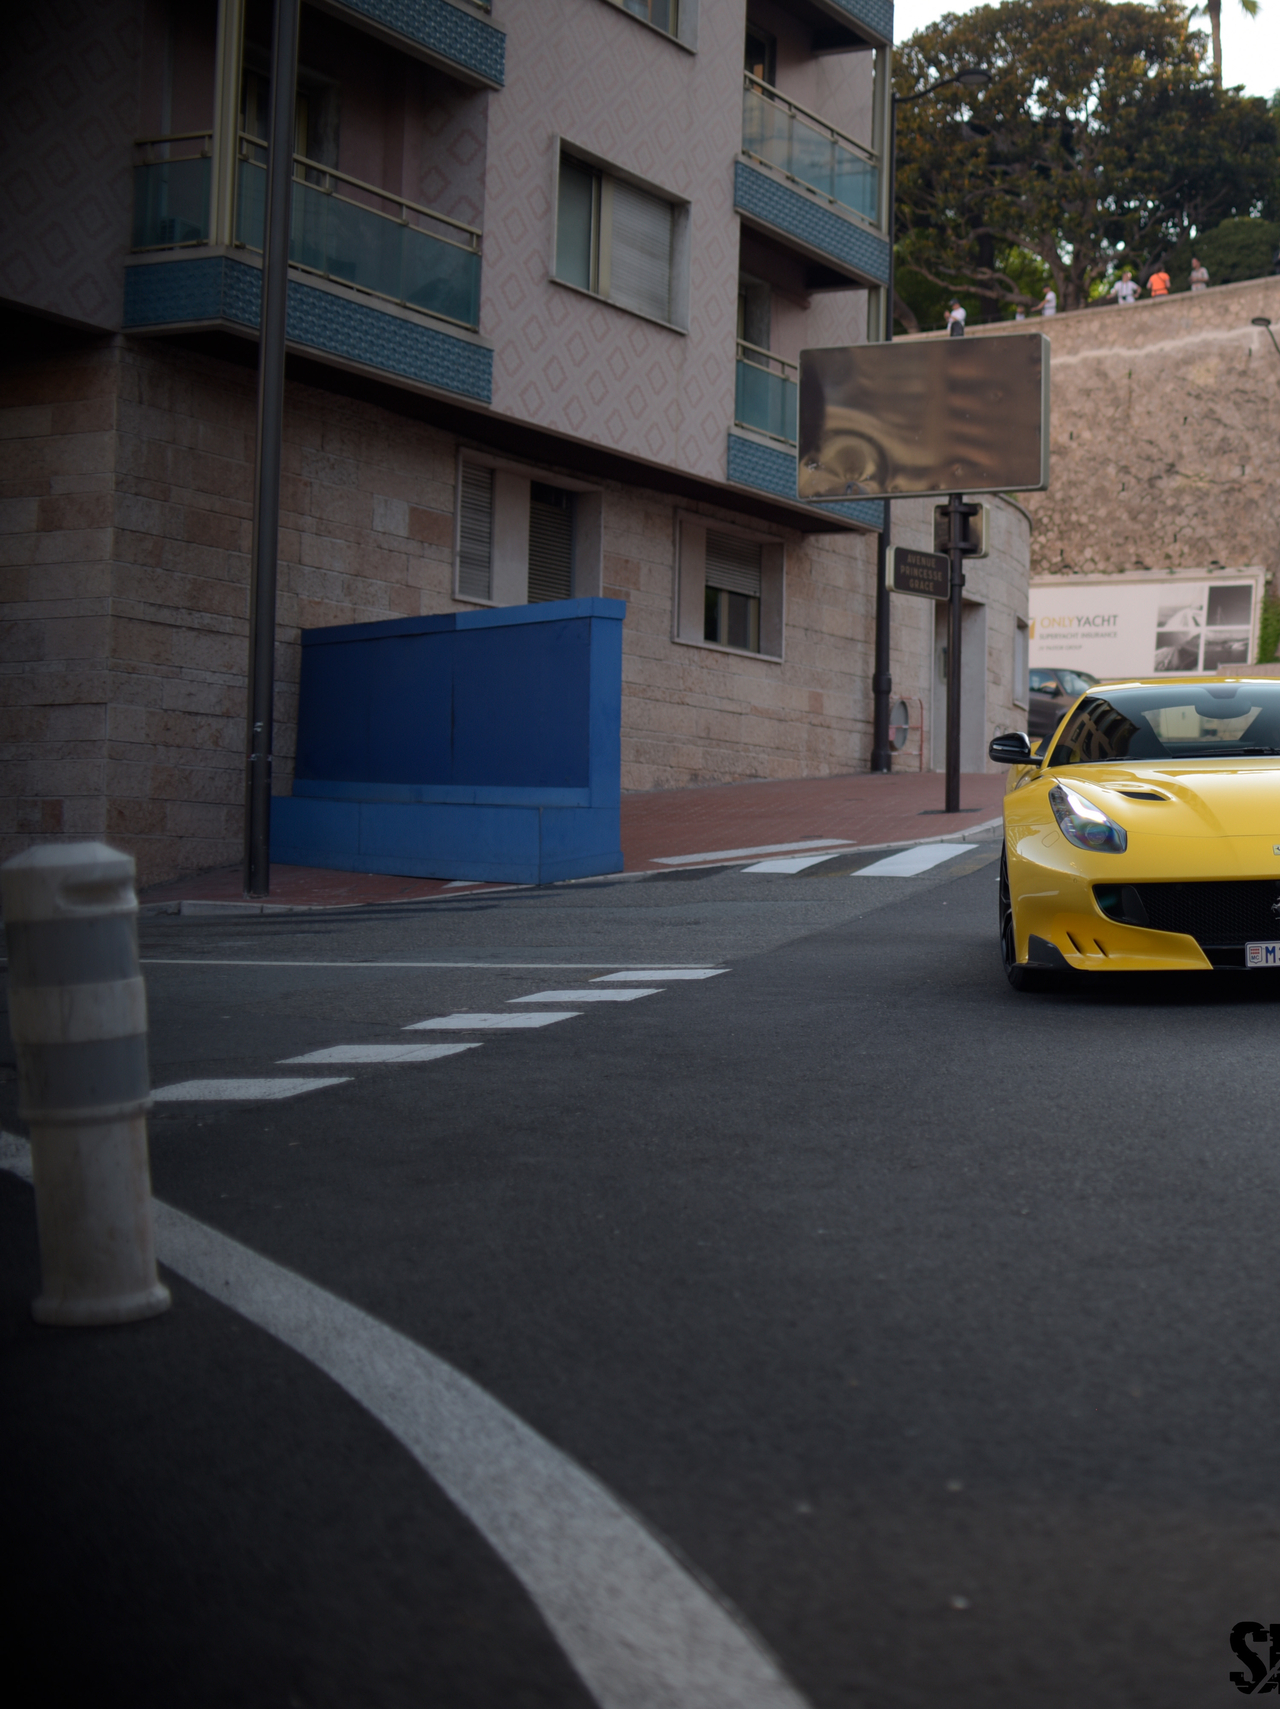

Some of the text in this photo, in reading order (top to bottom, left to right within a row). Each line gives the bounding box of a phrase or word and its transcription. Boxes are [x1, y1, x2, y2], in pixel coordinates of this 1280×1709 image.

[907, 554, 936, 568] AVENUE
[900, 565, 943, 582] PRINCESSE
[909, 579, 935, 592] GRACE
[1039, 631, 1118, 640] SUPERYACHT INSURANCE
